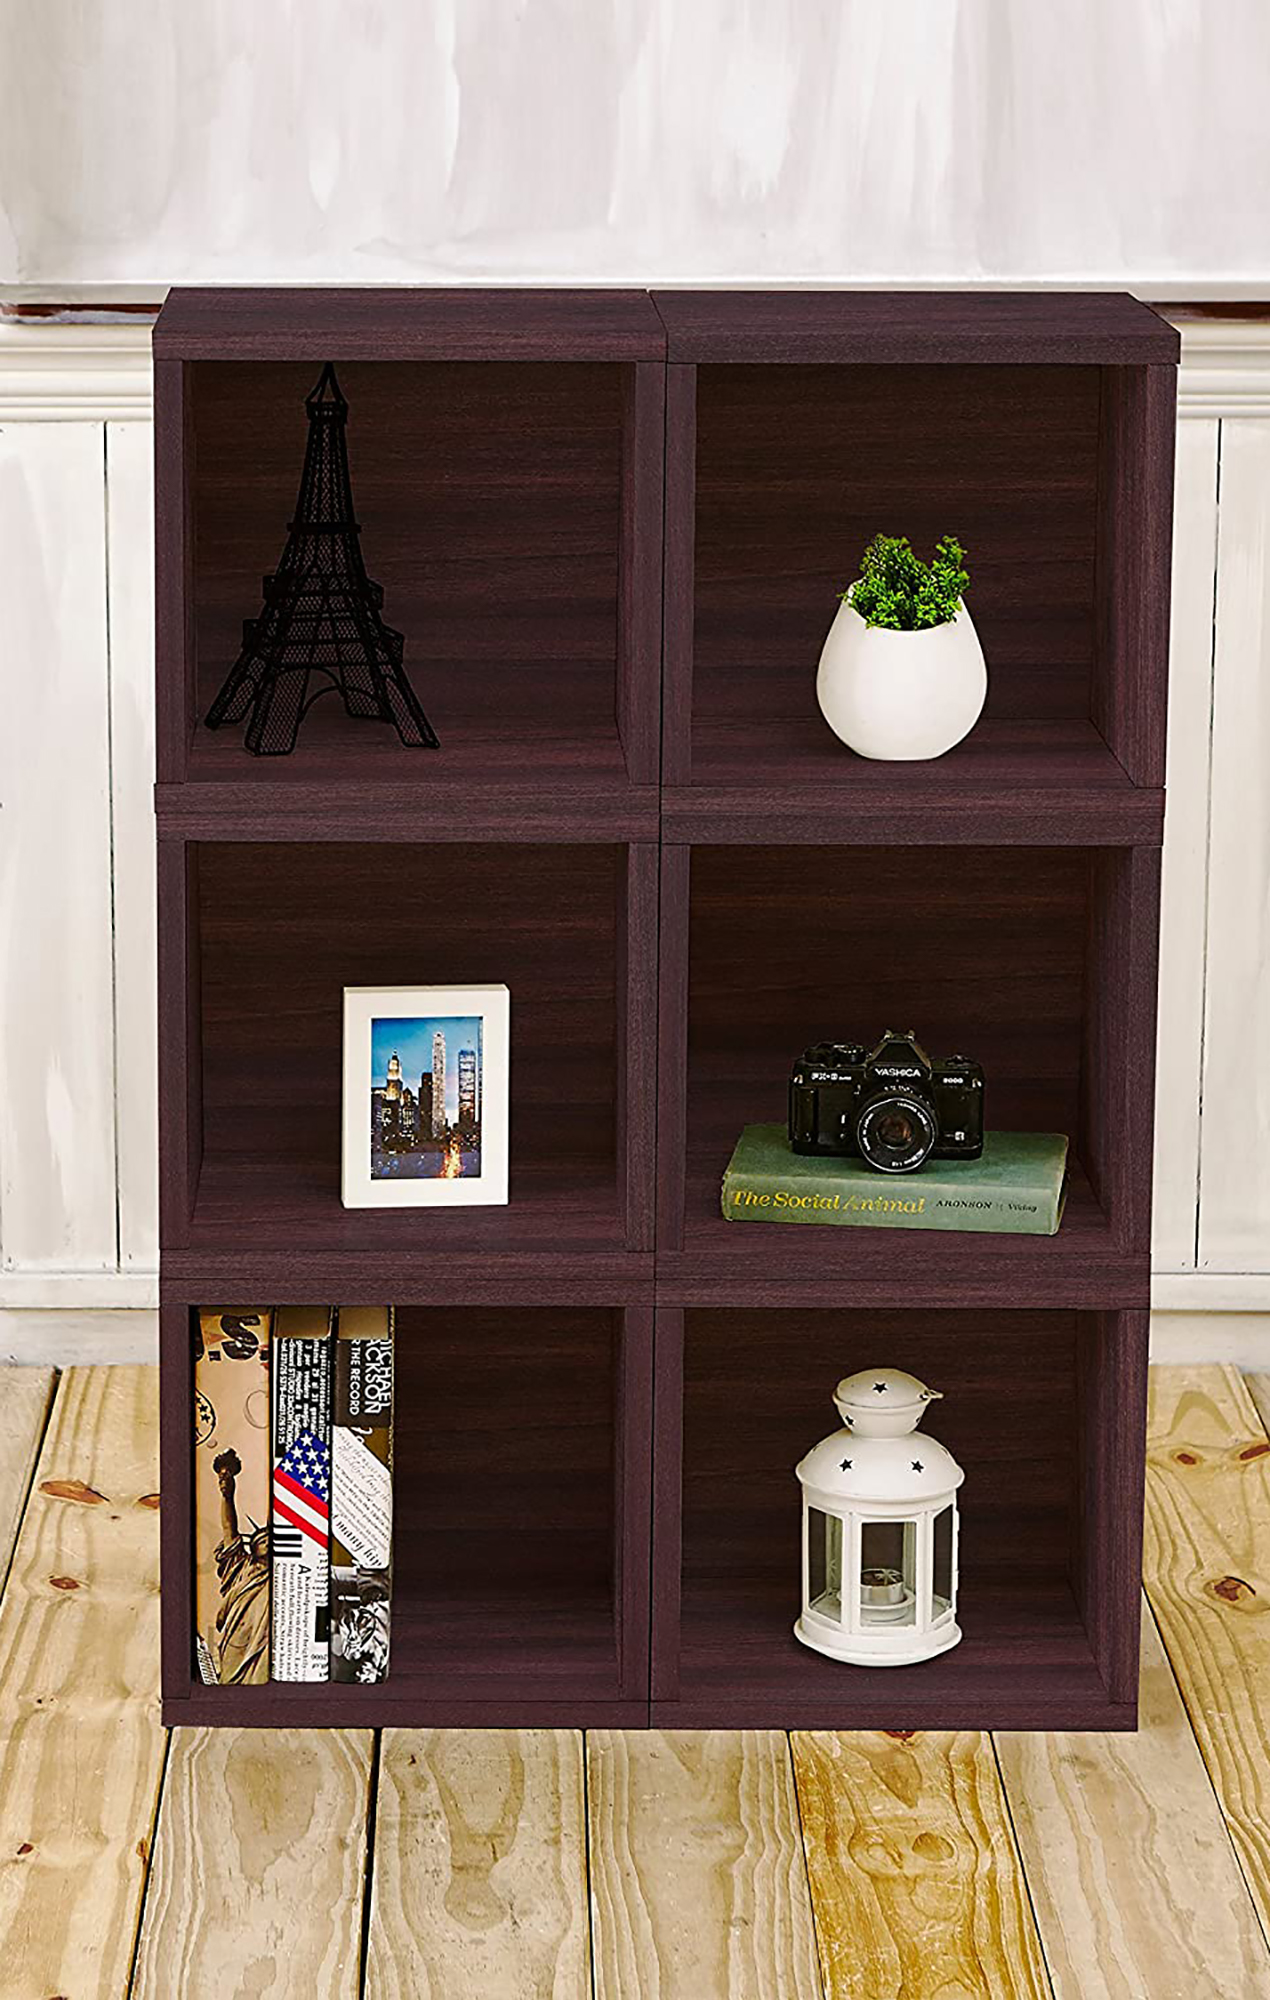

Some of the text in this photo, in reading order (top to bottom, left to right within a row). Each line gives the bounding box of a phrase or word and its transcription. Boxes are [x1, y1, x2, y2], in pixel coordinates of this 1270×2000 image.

[874, 1067, 922, 1078] YASHICA
[731, 1190, 770, 1208] The
[773, 1192, 840, 1210] Social
[842, 1195, 926, 1214] Animal
[936, 1200, 992, 1210] ARONSON
[350, 1347, 360, 1365] THE
[349, 1368, 360, 1415] RECORD
